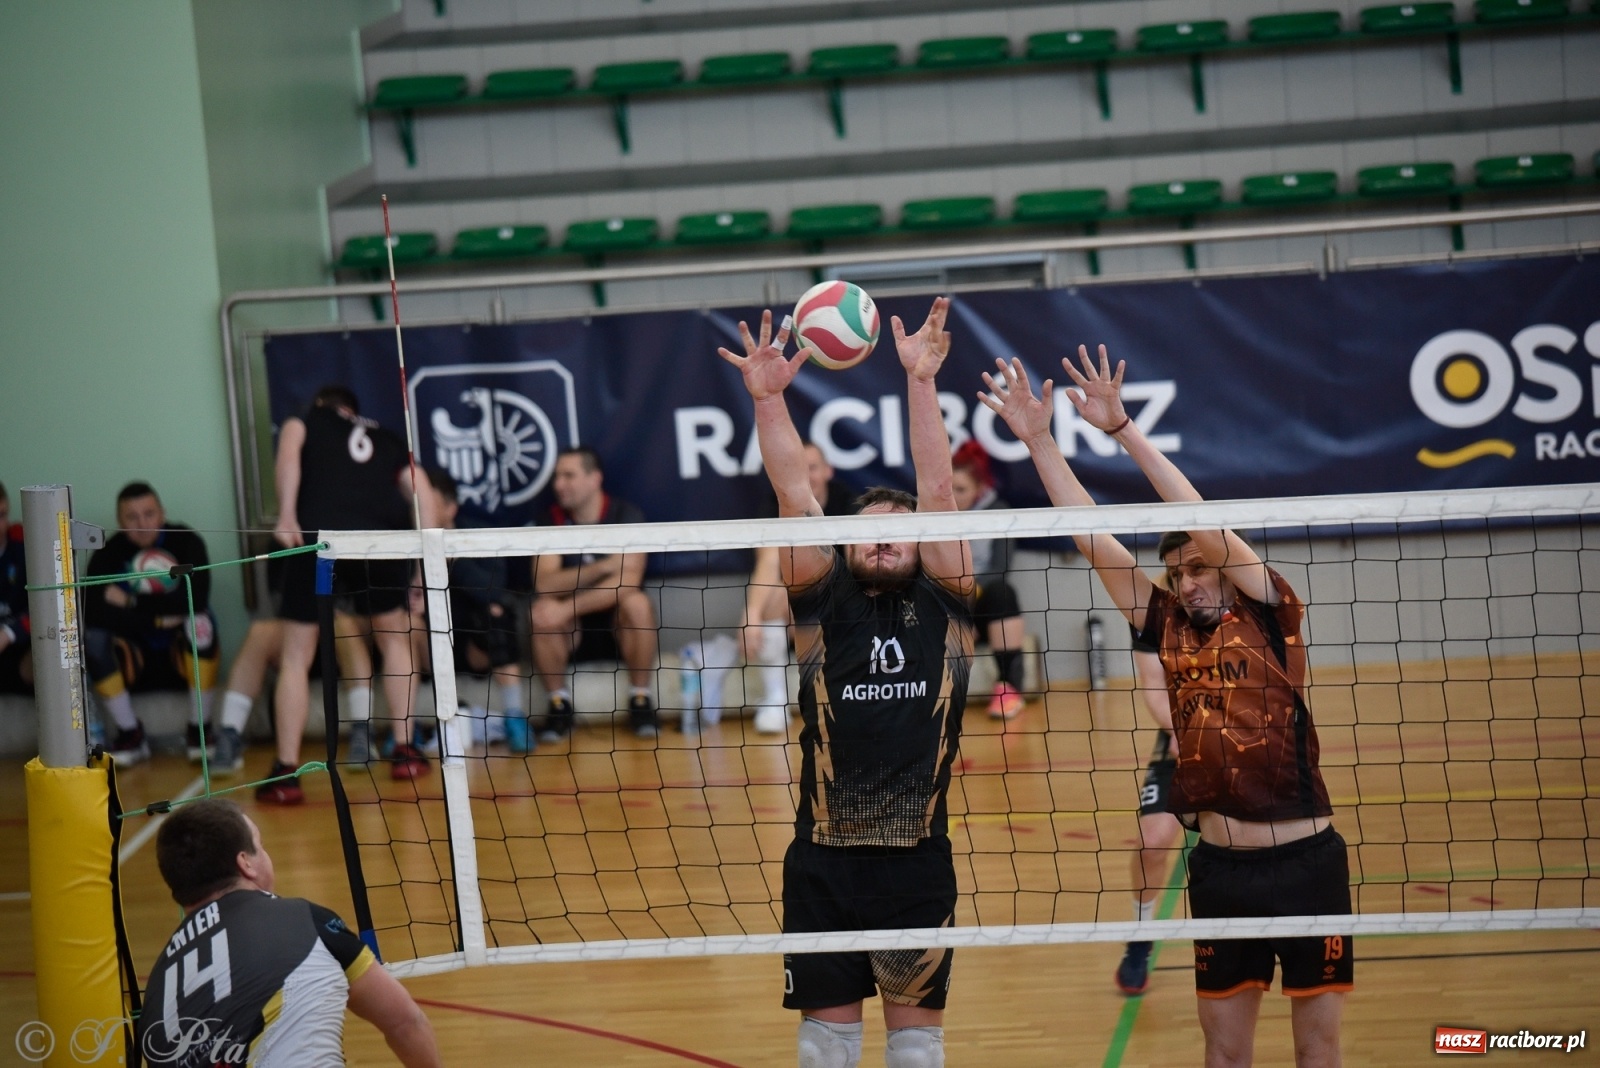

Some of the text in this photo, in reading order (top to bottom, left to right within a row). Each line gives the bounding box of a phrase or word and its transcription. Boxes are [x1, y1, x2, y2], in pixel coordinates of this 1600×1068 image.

[348, 424, 374, 463] 6
[869, 636, 905, 674] 10
[841, 681, 926, 700] AGROTIM
[1324, 935, 1343, 960] 19
[163, 928, 232, 1043] 14
